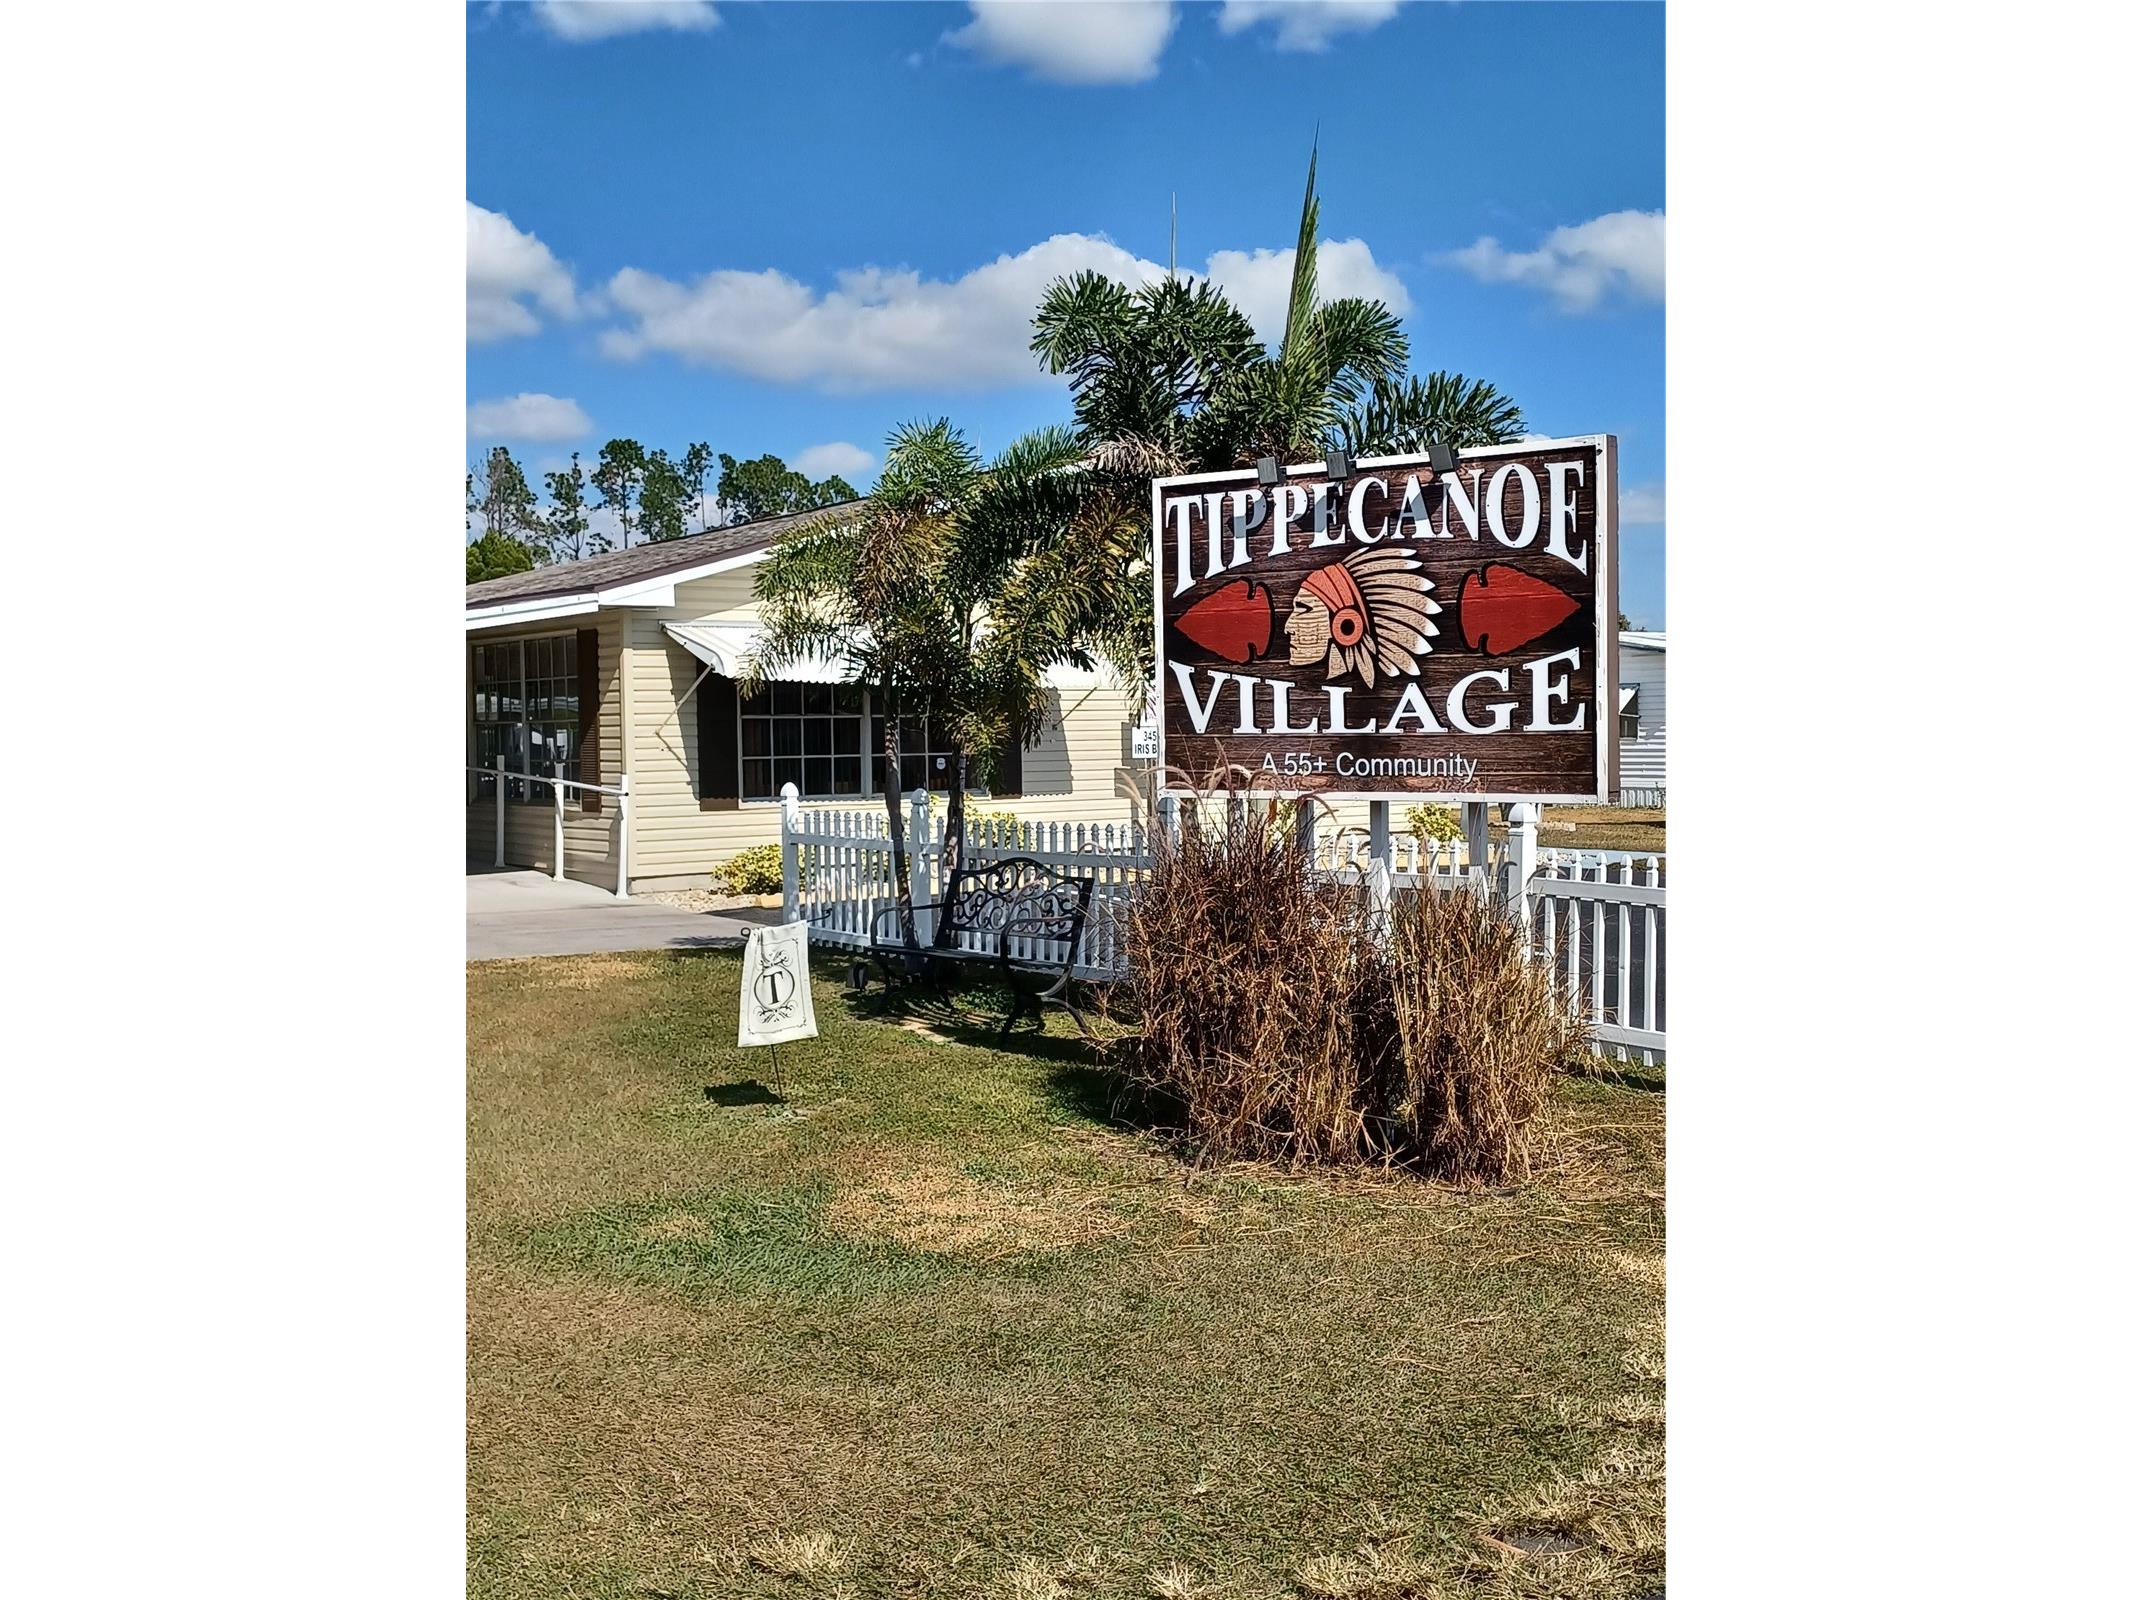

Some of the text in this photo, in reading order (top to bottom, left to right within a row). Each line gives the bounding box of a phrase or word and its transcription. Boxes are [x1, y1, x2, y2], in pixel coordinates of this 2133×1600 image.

[1165, 460, 1589, 599] TIPPECANOE
[1168, 647, 1587, 735] VILLAGE
[1134, 743, 1150, 755] IRIS
[1261, 751, 1478, 783] A 55+ Community
[762, 971, 783, 1004] T
